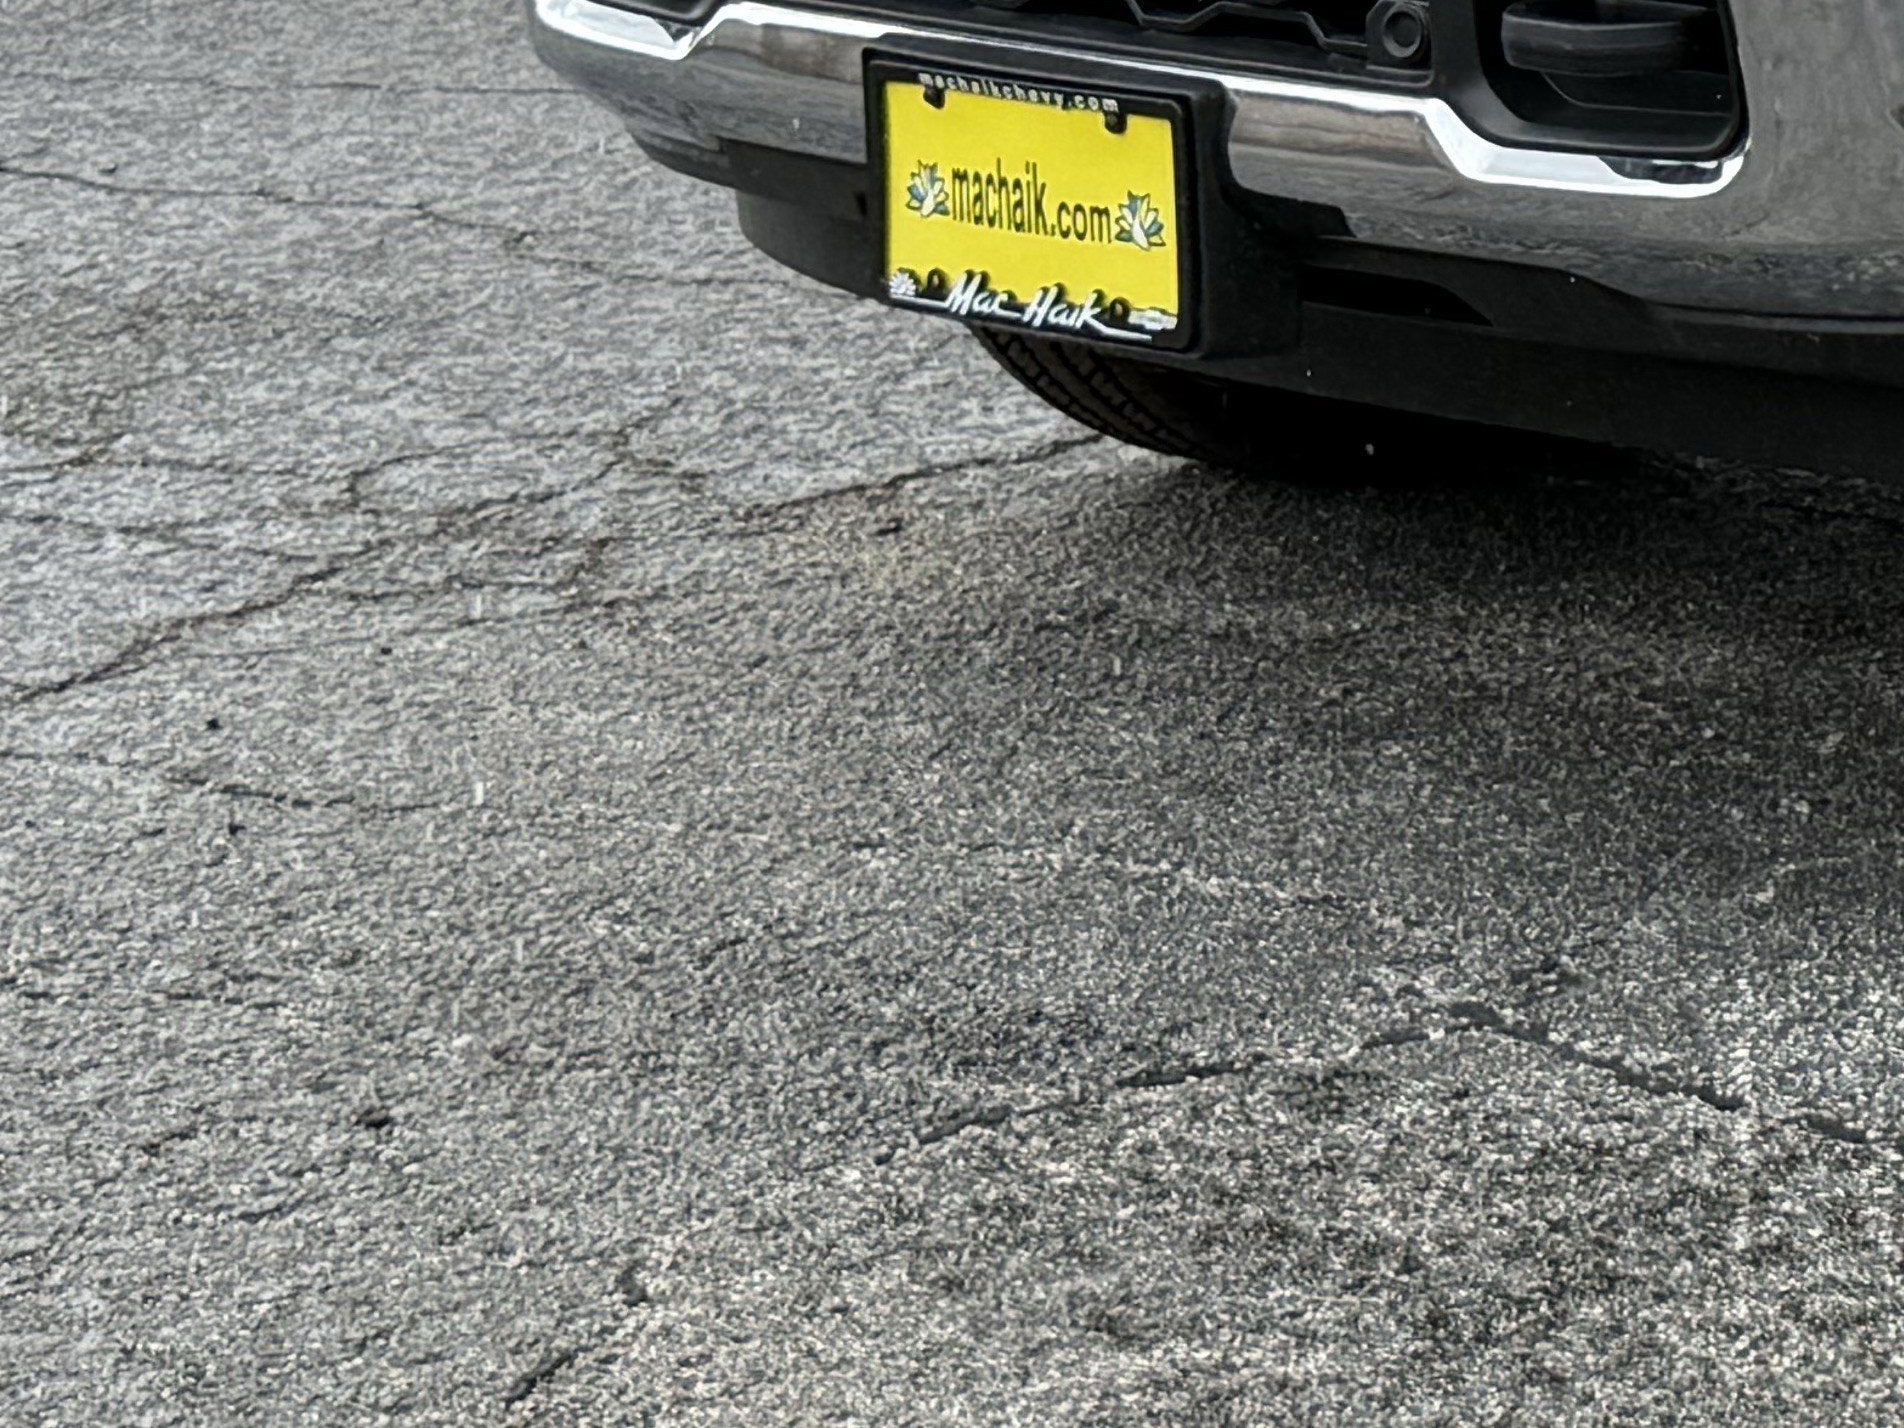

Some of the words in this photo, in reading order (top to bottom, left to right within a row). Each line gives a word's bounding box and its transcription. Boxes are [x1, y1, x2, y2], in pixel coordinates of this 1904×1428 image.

[917, 71, 1120, 113] machaikchevy.com
[950, 156, 1112, 244] machaik.com
[945, 272, 1022, 317] Mac
[1022, 283, 1122, 333] Haik
